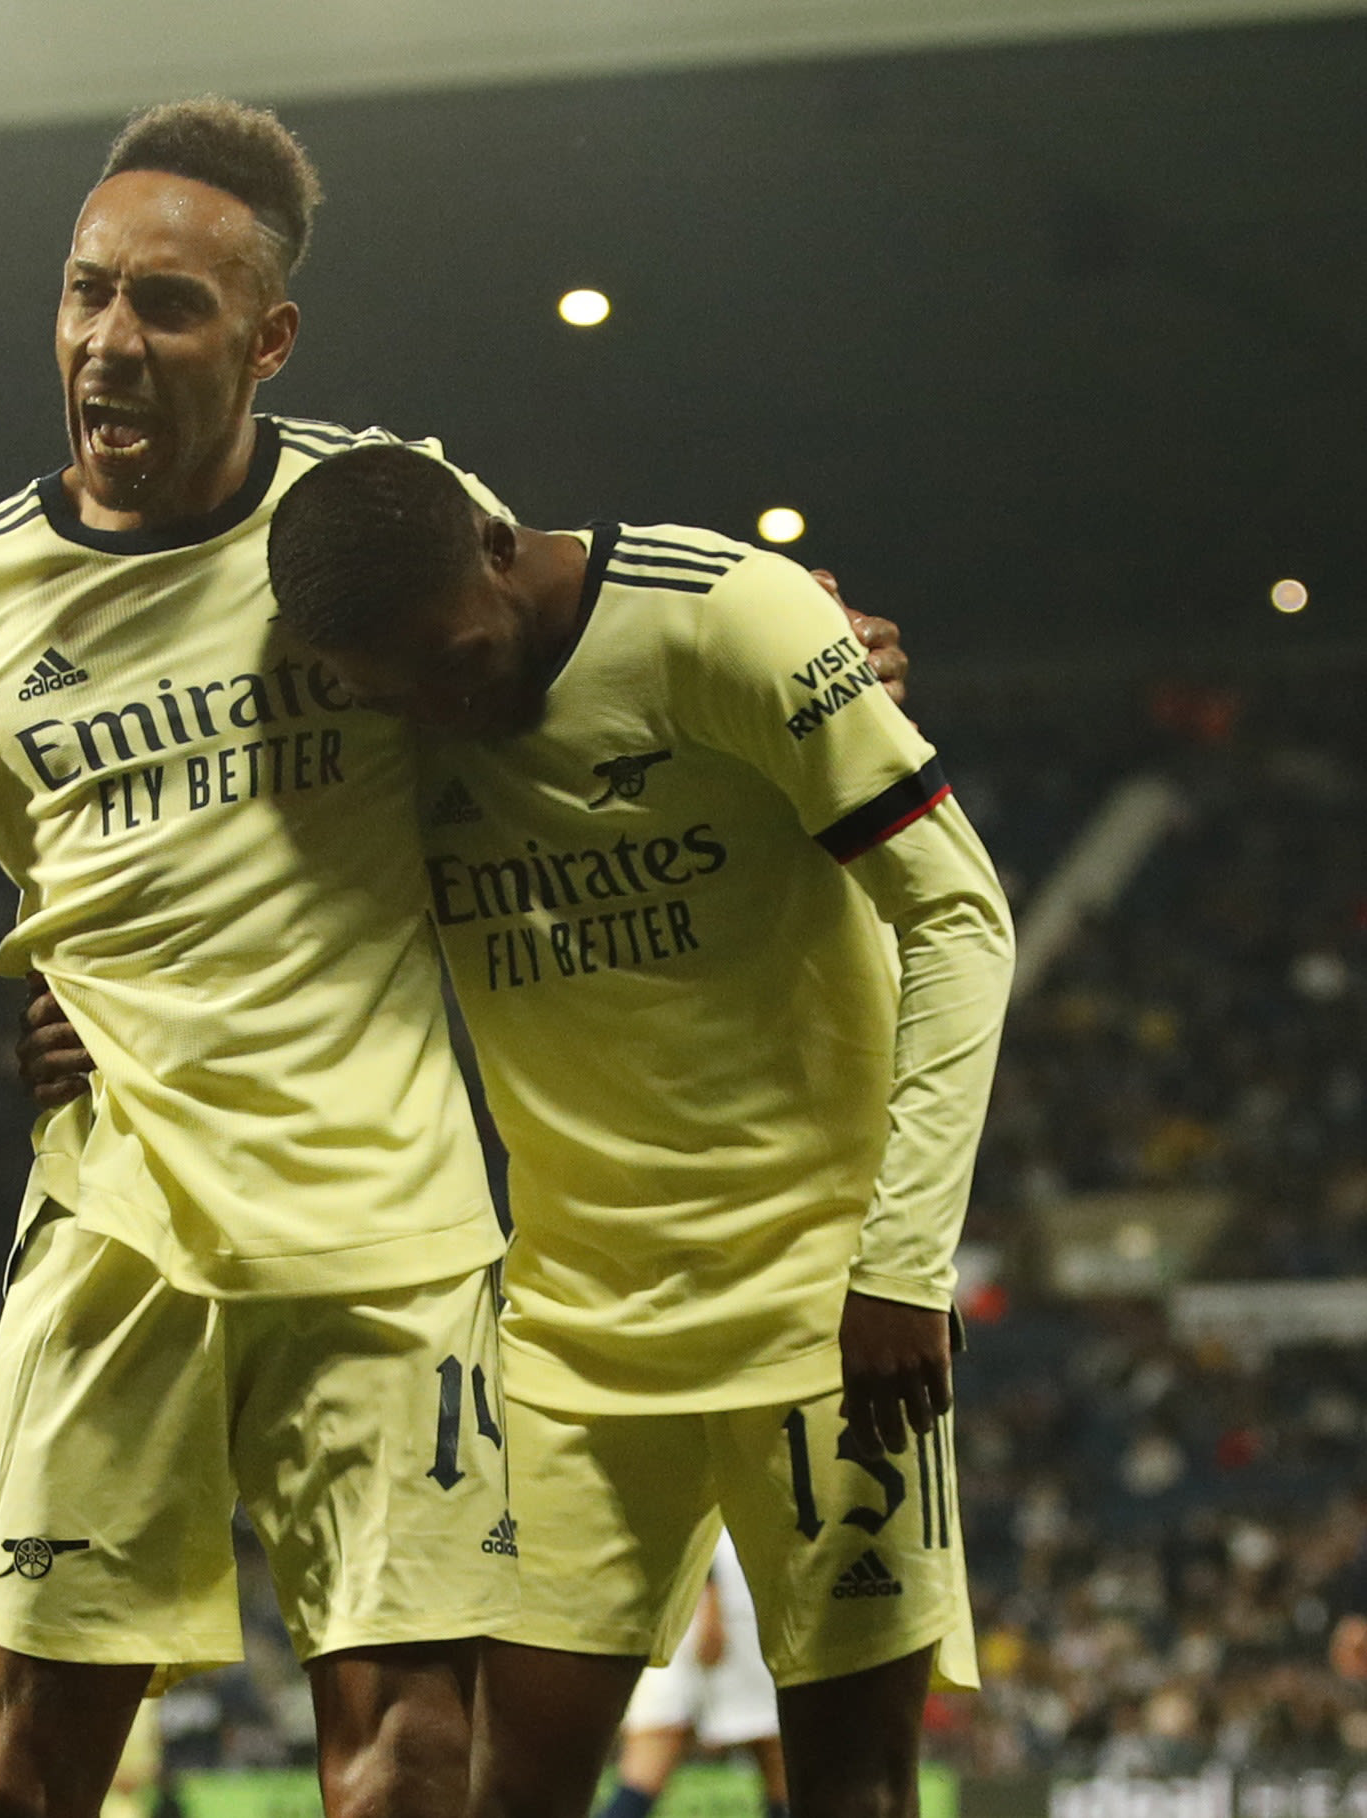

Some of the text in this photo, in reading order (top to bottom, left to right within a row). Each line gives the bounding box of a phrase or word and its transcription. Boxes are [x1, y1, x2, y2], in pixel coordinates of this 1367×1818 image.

[18, 667, 89, 702] adidas
[786, 661, 881, 741] RWAN
[791, 636, 860, 691] VISIT
[15, 653, 354, 793] Emirate
[98, 729, 346, 837] FLY BETTER
[426, 823, 728, 926] Emirates
[486, 900, 701, 992] FLY BETTER
[832, 1580, 903, 1600] adidas
